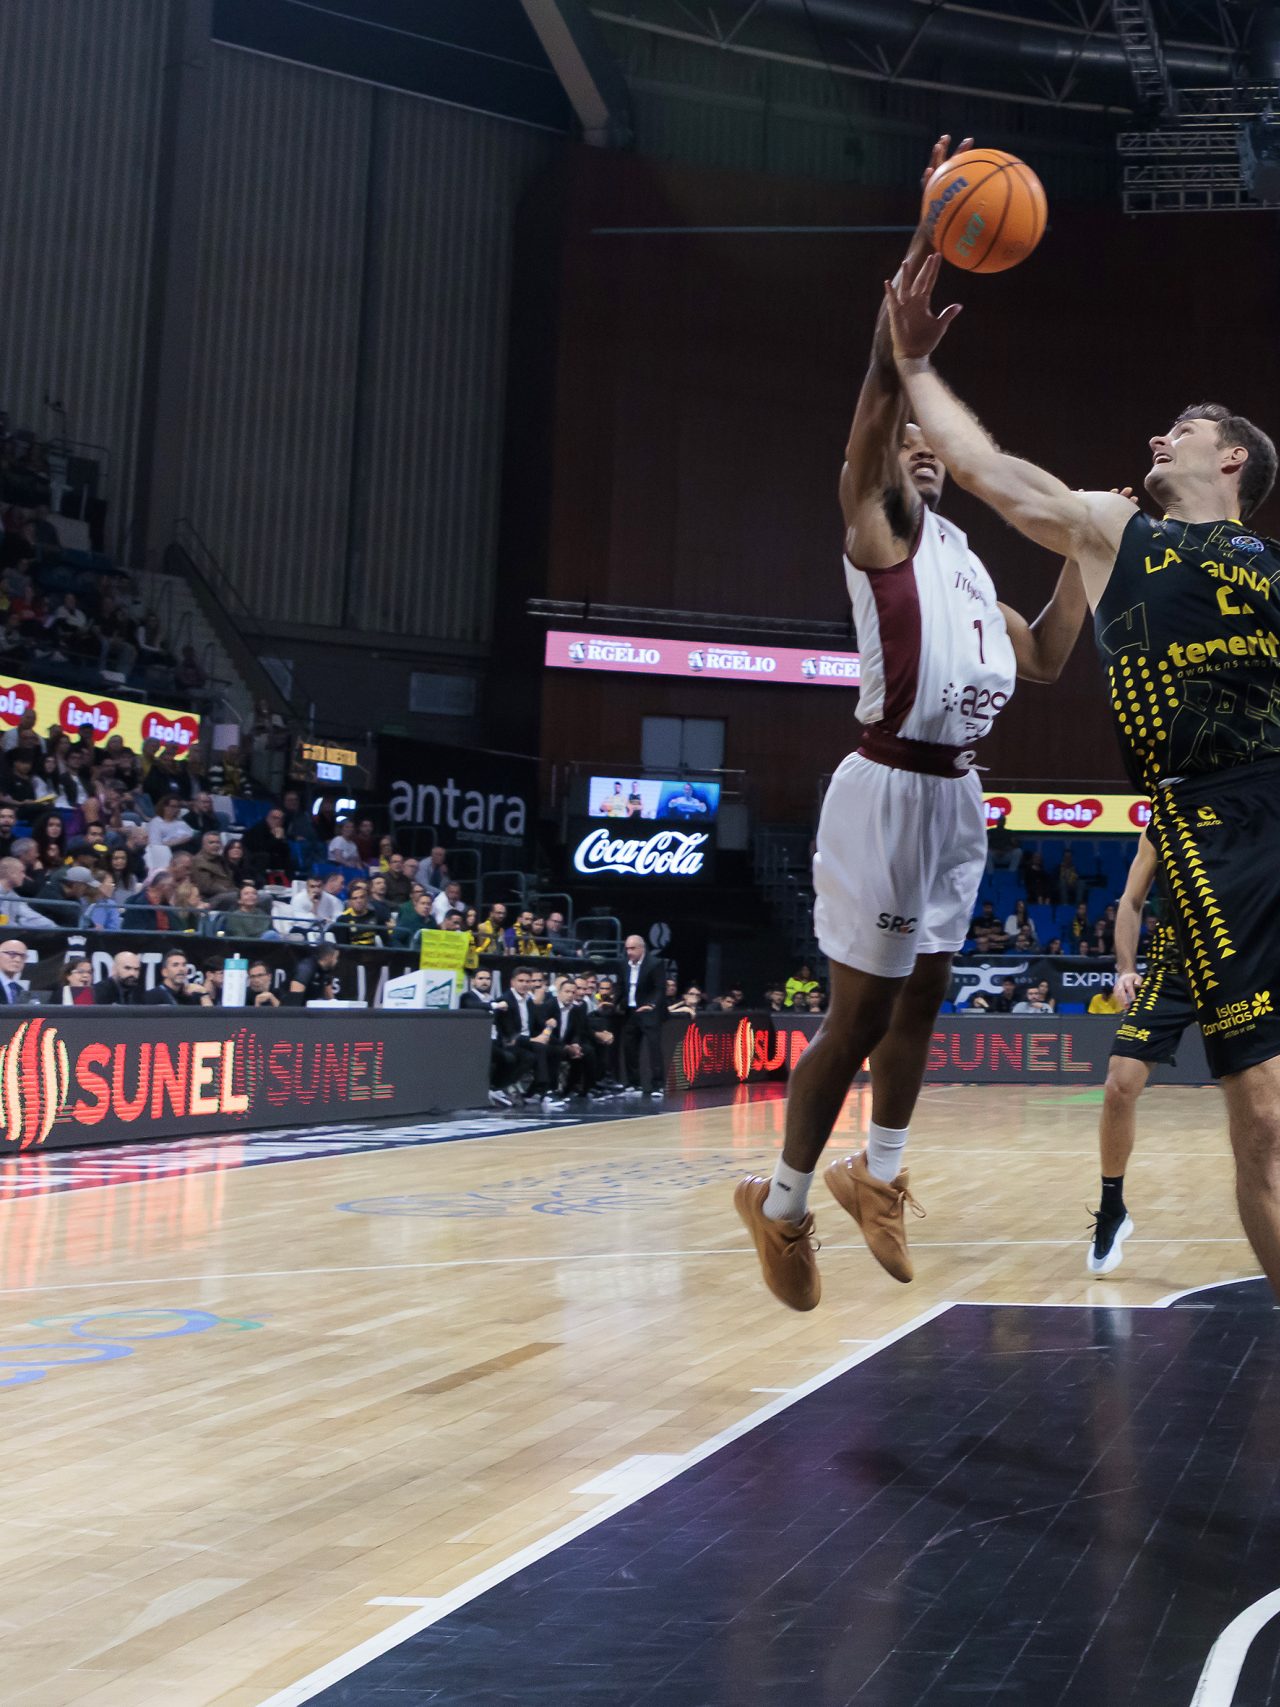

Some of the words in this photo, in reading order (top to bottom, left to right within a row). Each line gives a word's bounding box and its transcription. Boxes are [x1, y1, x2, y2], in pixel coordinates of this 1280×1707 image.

[1200, 560, 1271, 601] GUNA
[568, 640, 660, 666] ARGELIO
[973, 619, 986, 664] 1
[688, 649, 776, 673] ARGELIO
[802, 656, 861, 679] ARGE
[67, 703, 109, 731] isola
[149, 718, 190, 745] isola
[389, 778, 526, 835] antara
[1046, 803, 1093, 822] isola
[574, 828, 709, 874] Coca-Cola
[1063, 972, 1119, 987] EXPR
[1215, 1000, 1250, 1019] Islas
[1202, 1011, 1254, 1037] Canarias
[927, 1033, 1092, 1072] SUNEL
[74, 1041, 250, 1126] SUNEL
[268, 1040, 394, 1107] SUNEL
